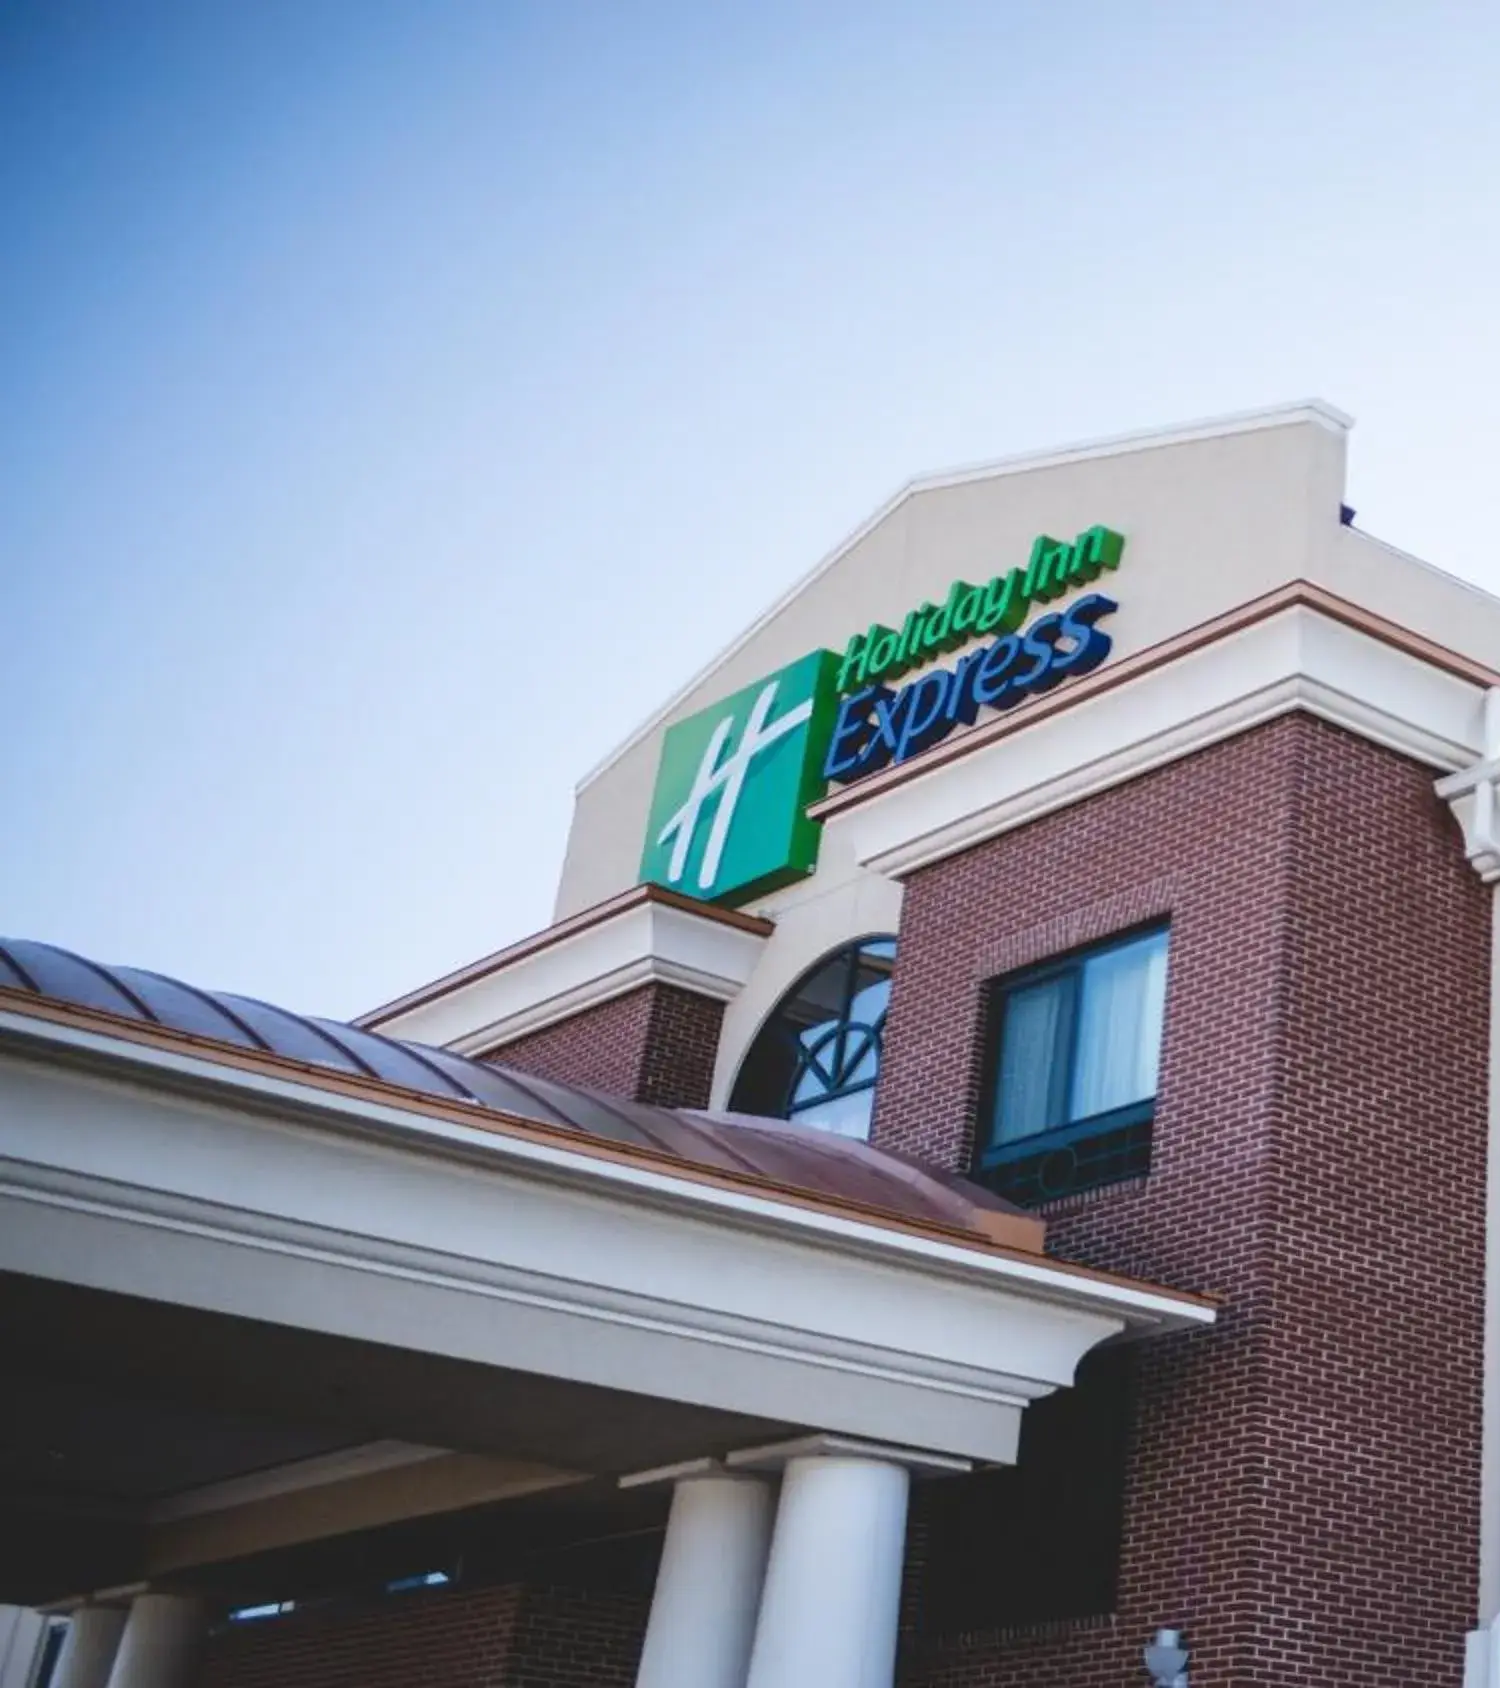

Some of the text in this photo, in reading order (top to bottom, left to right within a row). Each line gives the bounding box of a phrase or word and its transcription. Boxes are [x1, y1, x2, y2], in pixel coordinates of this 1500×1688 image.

[823, 593, 1115, 783] Express
[836, 524, 1120, 693] Holiday Inn
